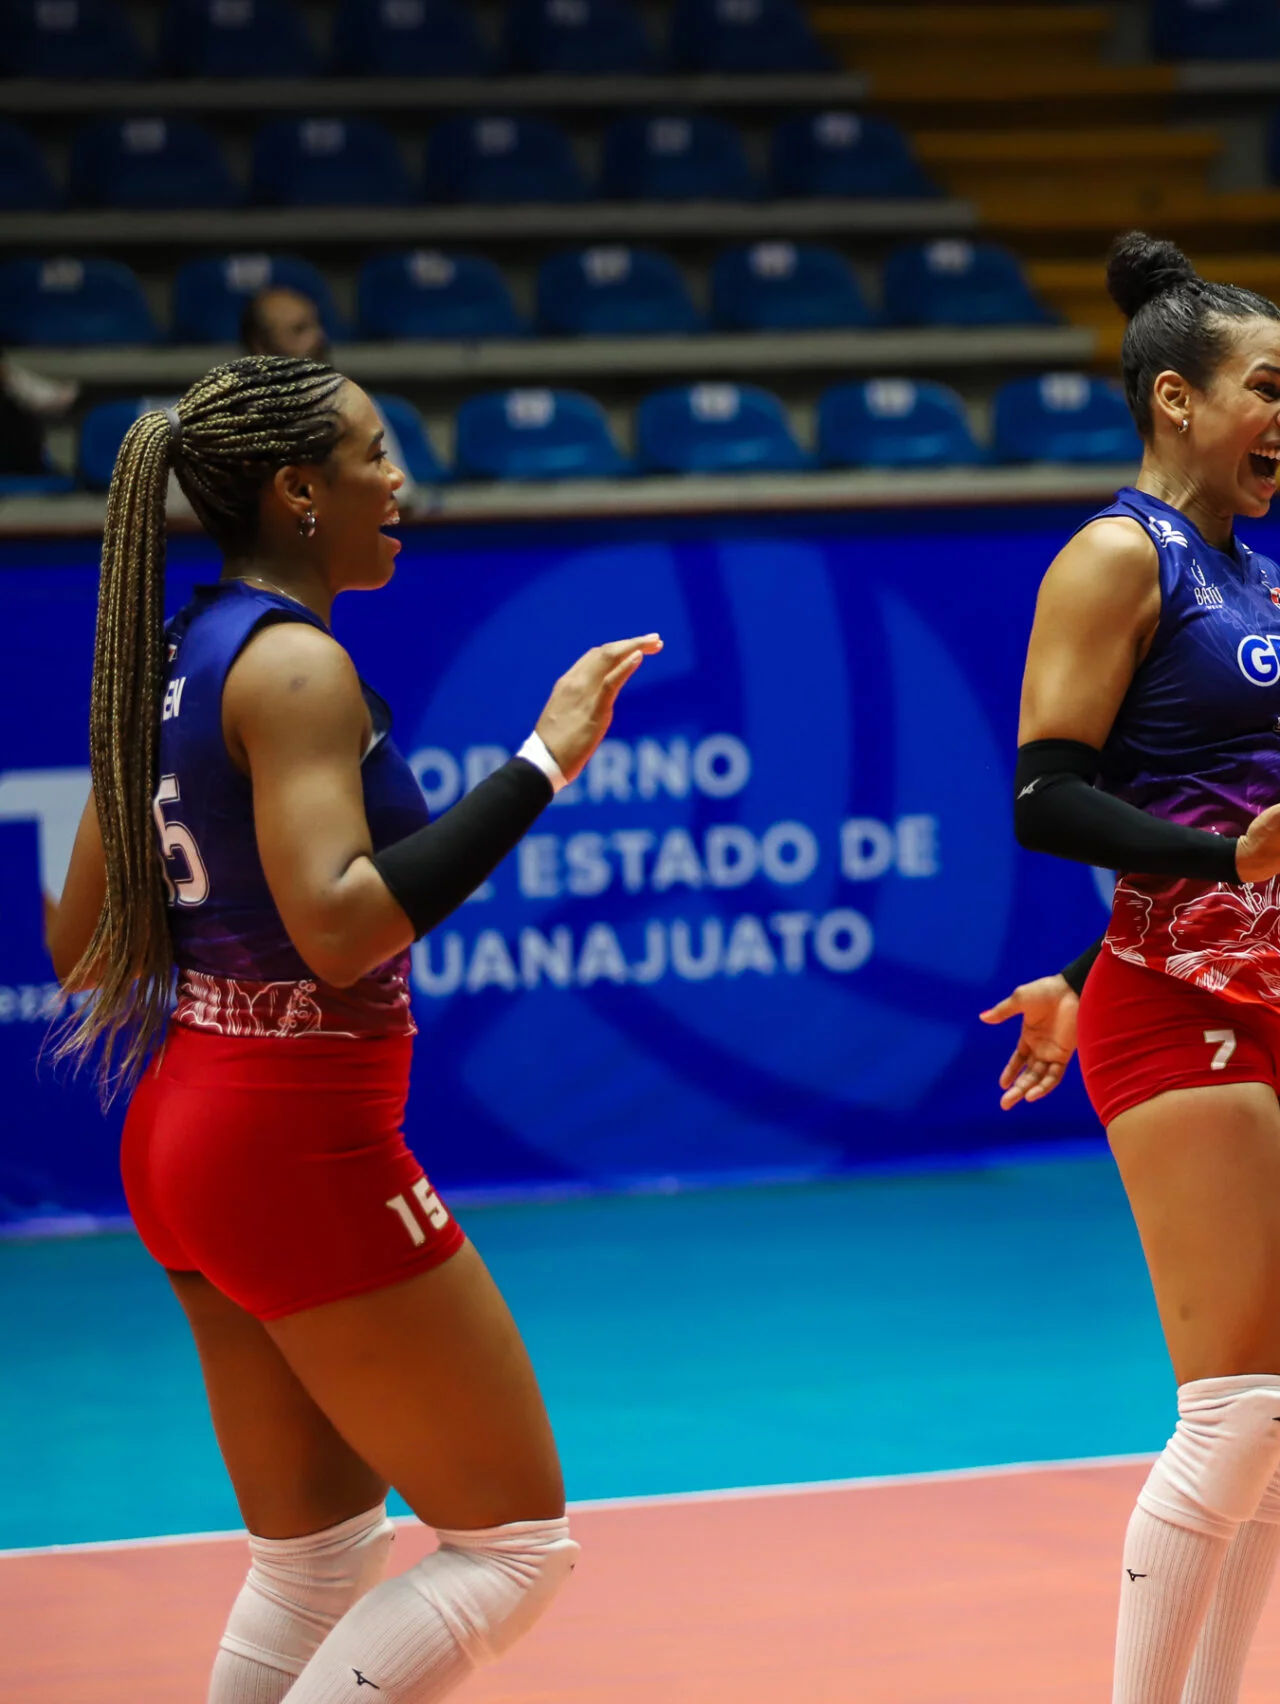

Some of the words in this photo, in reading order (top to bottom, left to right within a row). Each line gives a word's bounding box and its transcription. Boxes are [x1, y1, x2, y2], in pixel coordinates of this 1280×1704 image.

[517, 820, 819, 899] ESTADO
[840, 813, 940, 881] DE
[409, 906, 874, 997] UANAJUATO
[1203, 1029, 1237, 1071] 7
[385, 1177, 449, 1247] 15
